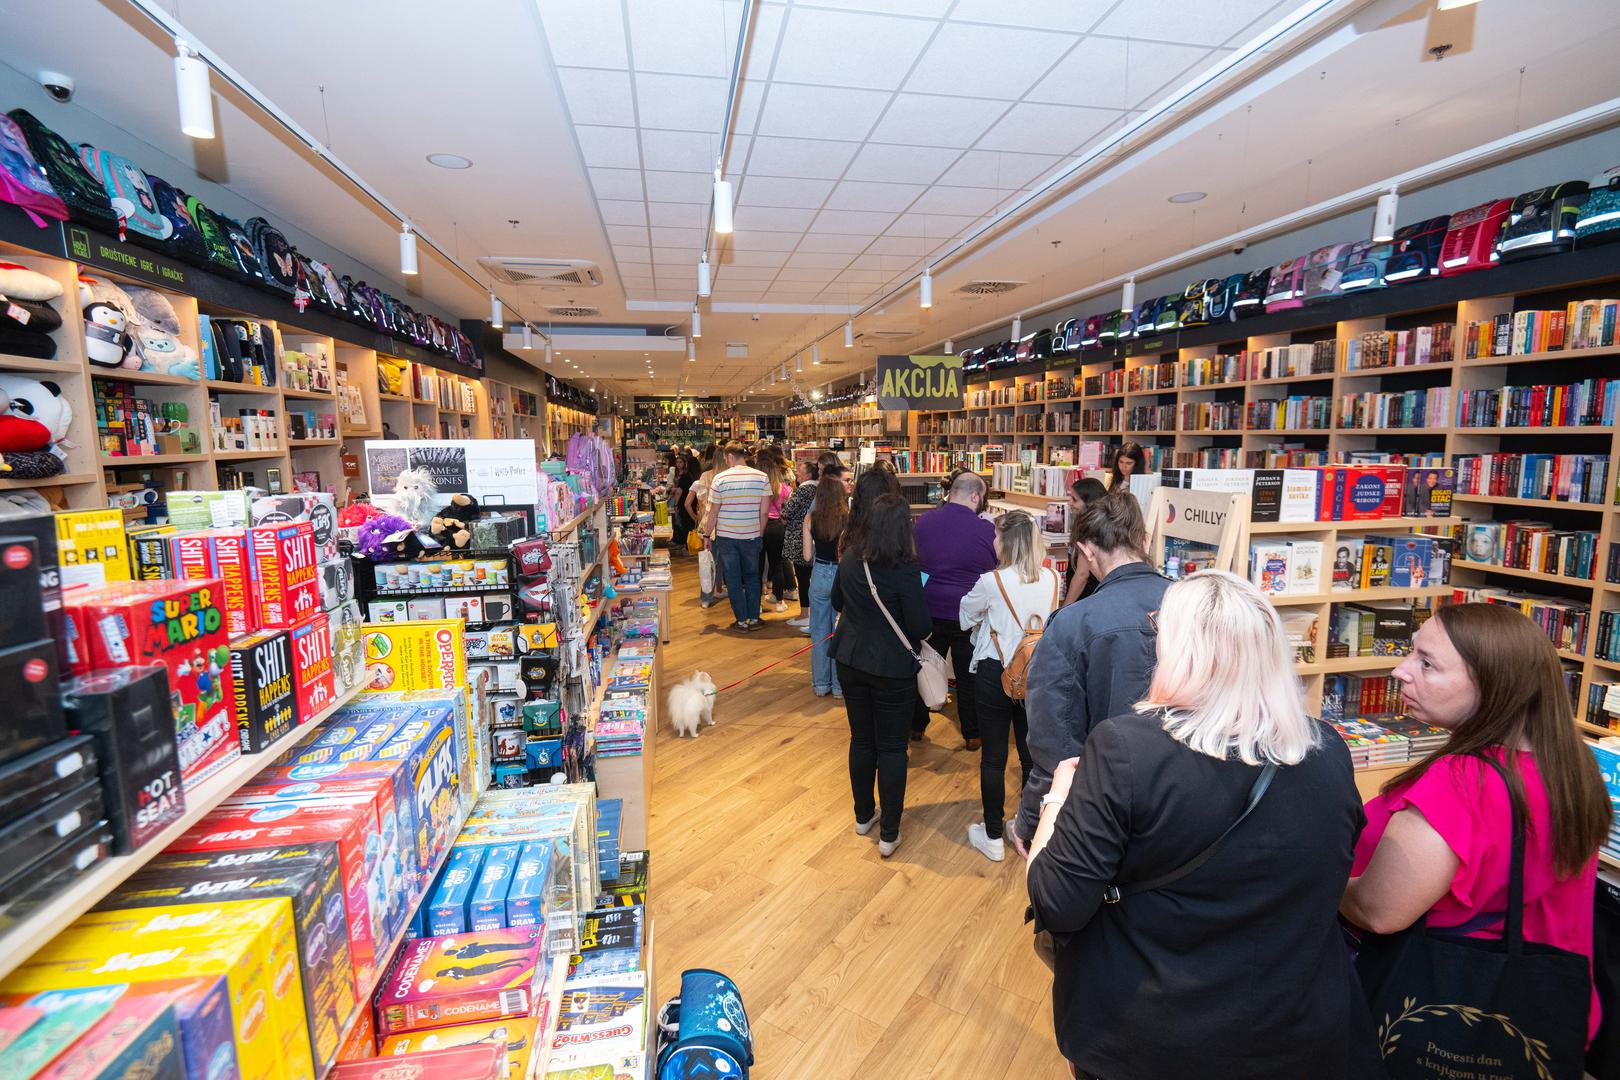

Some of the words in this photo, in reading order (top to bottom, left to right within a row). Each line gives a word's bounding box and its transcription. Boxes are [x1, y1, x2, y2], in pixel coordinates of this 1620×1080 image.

[100, 246, 137, 268] DRUŠTVENE
[140, 259, 154, 273] IGRE
[162, 266, 184, 283] IGRAČKE
[881, 368, 959, 398] AKCIJA
[432, 476, 463, 485] RONES
[1431, 495, 1451, 503] OTAC
[1184, 508, 1227, 525] CHILLY'
[180, 539, 205, 566] SHIT
[215, 538, 240, 565] SHIT
[253, 530, 277, 557] SHIT
[283, 533, 312, 573] SHIT
[222, 565, 245, 609] HAPPENS
[260, 556, 282, 602] HAPPENS
[286, 565, 317, 587] HAPPENS
[151, 588, 212, 623] SUPER
[144, 607, 222, 656] MARIO
[255, 636, 286, 689] SHIT
[298, 627, 327, 670] SHIT
[436, 629, 455, 690] OPERATIO
[301, 658, 330, 684] HAPPENS
[259, 674, 291, 709] HAPPENS
[137, 771, 172, 806] HOT
[135, 787, 179, 829] SEAT
[434, 928, 459, 936] DRAW
[475, 923, 500, 931] DRAW
[511, 918, 535, 927] DRAW
[395, 939, 432, 998] CODENAMES
[444, 1001, 499, 1016] CODENAME
[1427, 1041, 1474, 1063] Provesti
[1477, 1054, 1502, 1066] dan
[1425, 1058, 1474, 1079] knjigom
